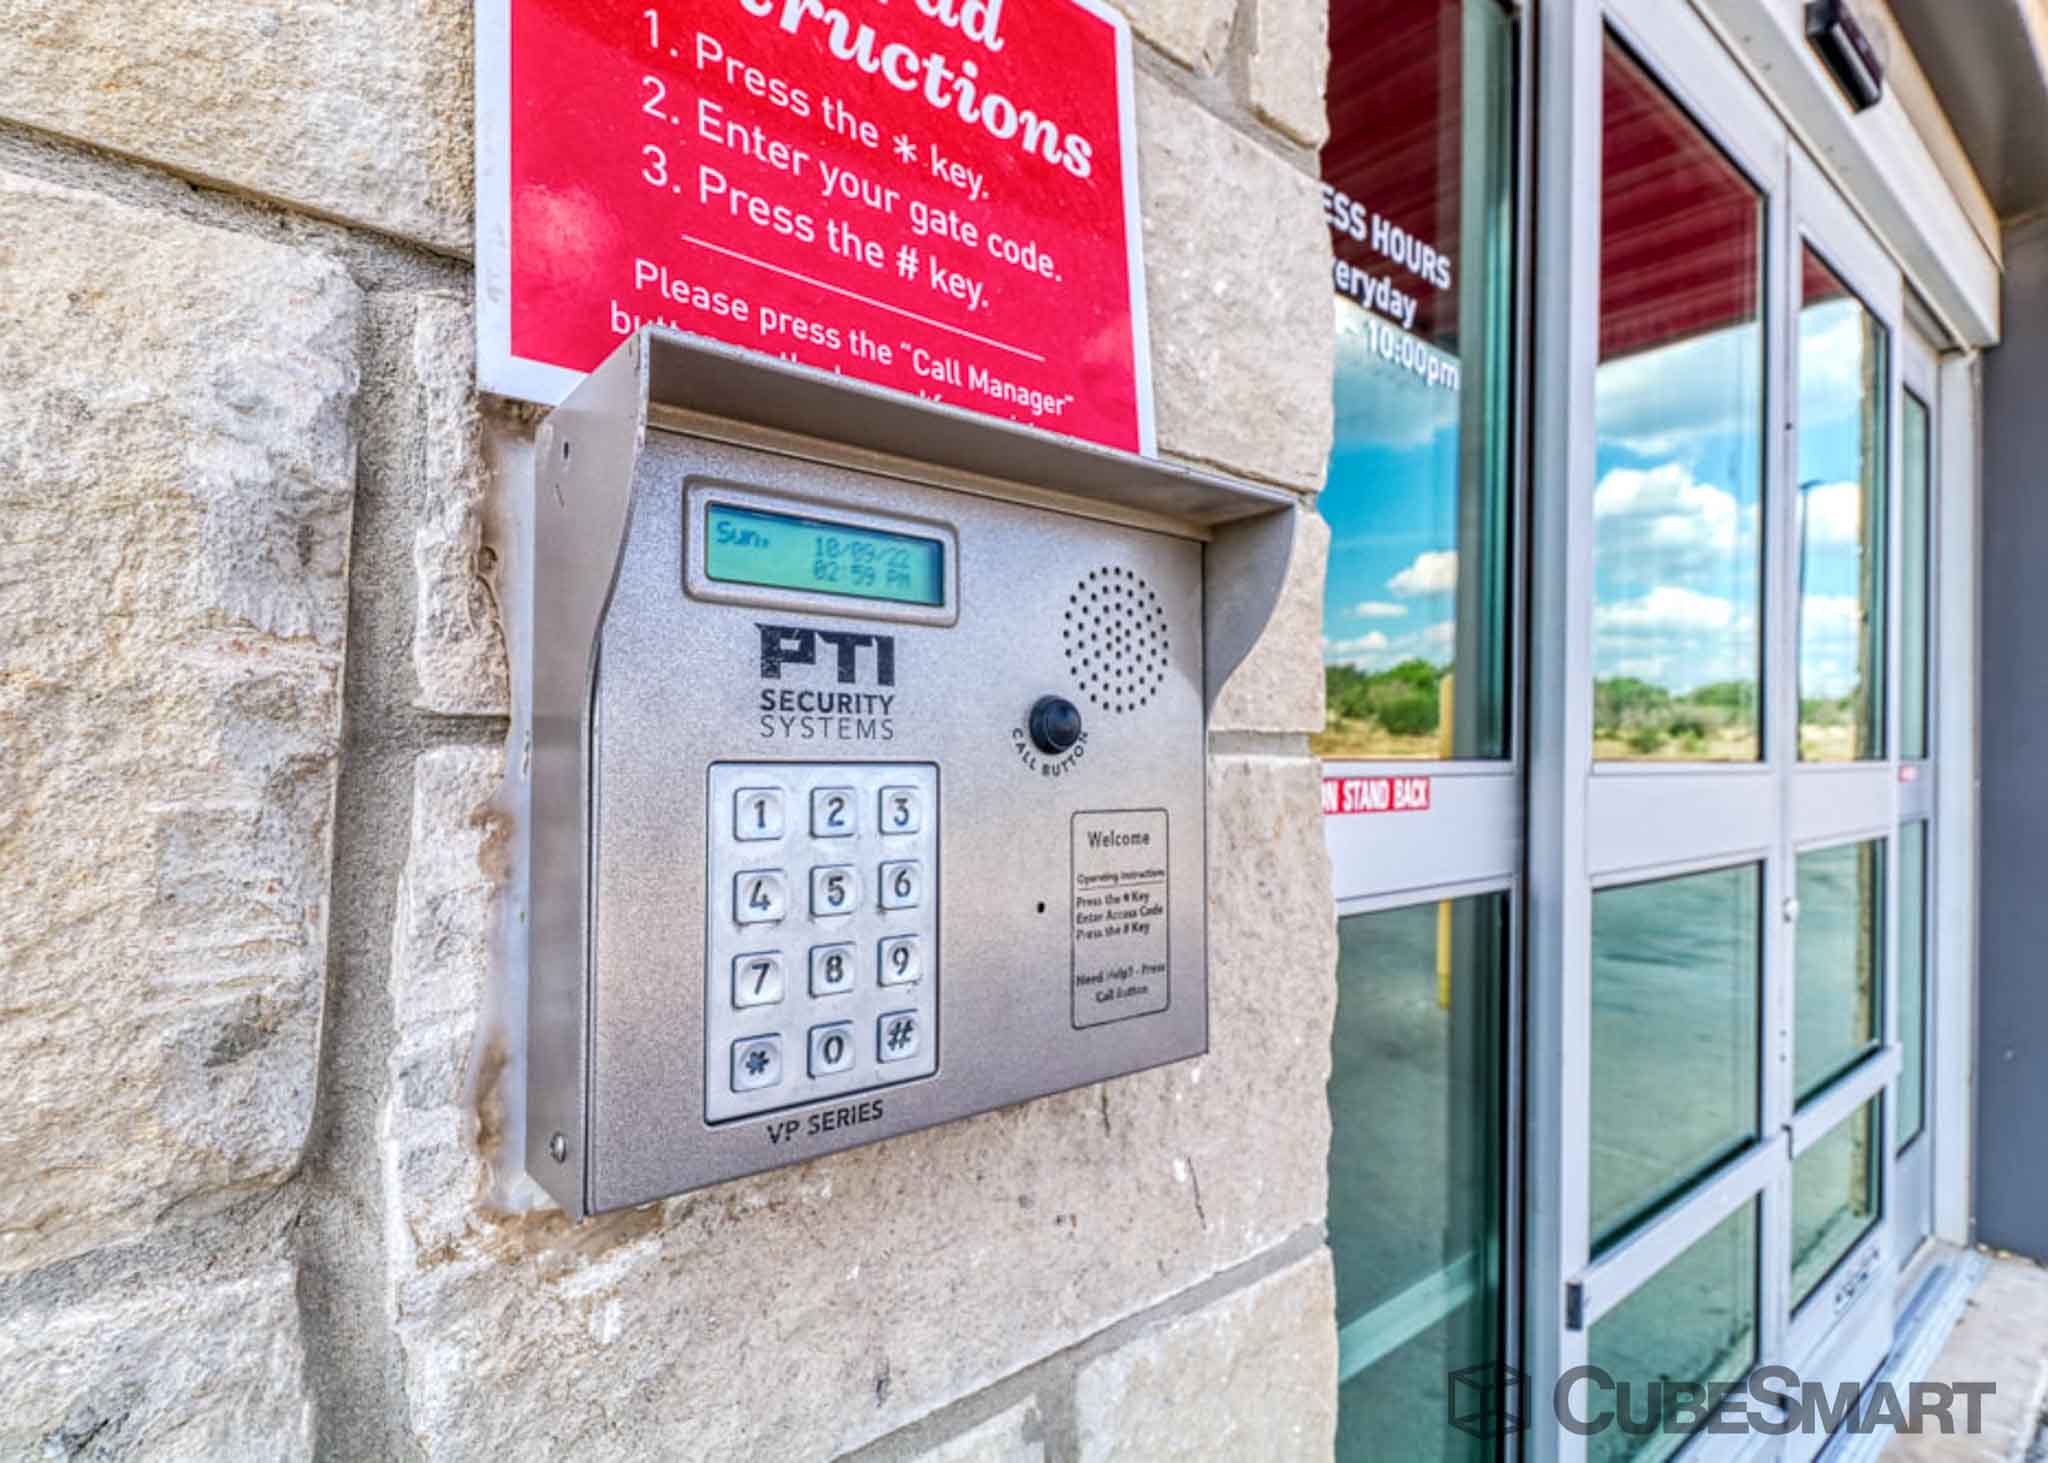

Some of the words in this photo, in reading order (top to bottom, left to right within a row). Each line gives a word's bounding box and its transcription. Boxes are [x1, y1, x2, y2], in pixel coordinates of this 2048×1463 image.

[643, 9, 679, 57] 1.
[696, 31, 811, 117] Press
[821, 95, 879, 148] the
[930, 144, 989, 200] key.
[642, 75, 680, 125] 2.
[699, 97, 810, 176] Enter
[819, 160, 900, 213] your
[909, 201, 978, 247] gate
[987, 233, 1063, 282] code.
[642, 144, 681, 194] 3.
[700, 165, 815, 242] Press
[827, 218, 884, 268] the
[896, 245, 918, 280] #
[929, 256, 989, 311] key.
[1321, 184, 1367, 241] ESS
[1372, 214, 1451, 290] HOURS
[635, 258, 749, 321] Please
[759, 307, 841, 349] press
[849, 330, 893, 365] the
[1333, 256, 1417, 329] eryday
[1366, 316, 1459, 390] 10:00pm
[754, 622, 895, 687] PTI
[760, 689, 895, 716] SECURITY
[760, 715, 894, 741] SYSTEMS
[1012, 727, 1037, 771] CALL
[1041, 731, 1089, 777] BUTTON
[753, 799, 766, 829] 1
[827, 797, 845, 828] 2
[893, 798, 909, 826] 3
[1343, 780, 1389, 811] STAND
[1394, 779, 1428, 808] BACK
[1087, 830, 1150, 848] Welcome
[749, 880, 770, 911] 4
[828, 876, 845, 907] 5
[894, 869, 911, 898] 6
[1076, 896, 1103, 908] Press
[1105, 894, 1120, 904] the
[1131, 892, 1149, 904] Key
[1076, 912, 1103, 924] Enter
[1106, 909, 1137, 920] Access
[1140, 904, 1163, 917] Code
[1076, 929, 1103, 940] Press
[1105, 926, 1121, 937] the
[1131, 922, 1150, 936] Key
[751, 963, 770, 995] 7
[825, 955, 843, 984] 8
[892, 947, 909, 975] 9
[1076, 971, 1104, 987] Need
[1095, 988, 1114, 1003] Call
[824, 1035, 843, 1065] 0
[887, 1021, 914, 1051] #
[766, 1119, 799, 1145] VP
[807, 1100, 884, 1136] SERIES
